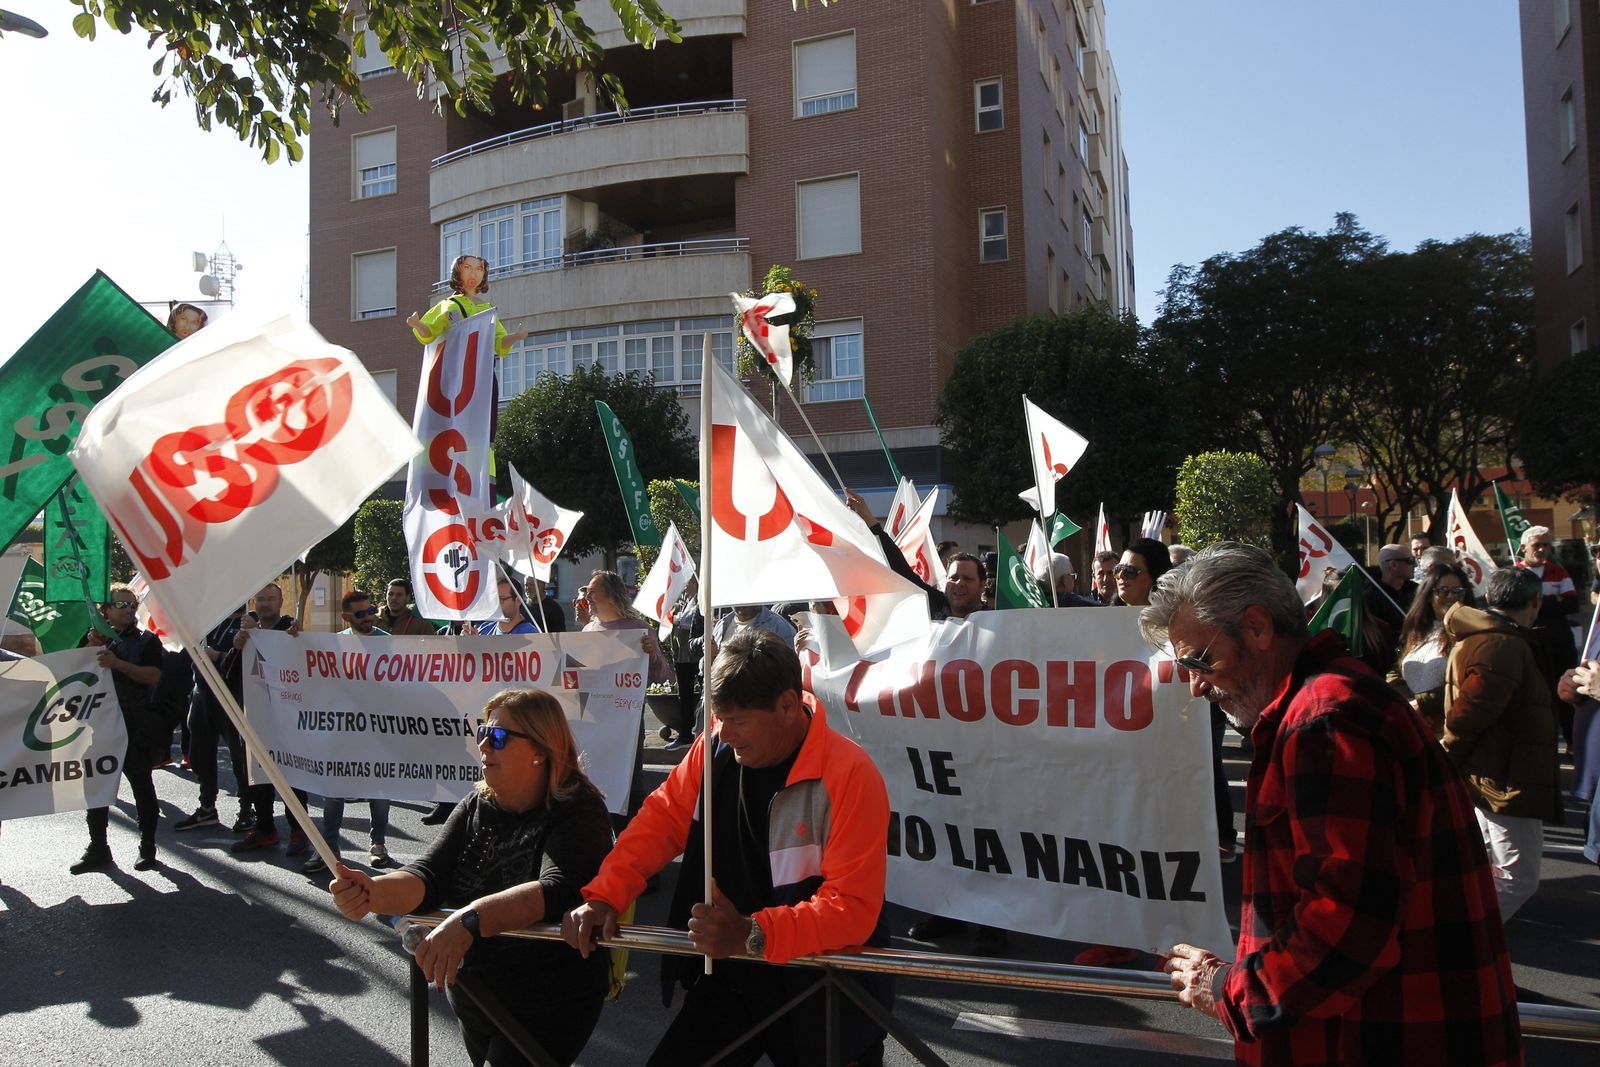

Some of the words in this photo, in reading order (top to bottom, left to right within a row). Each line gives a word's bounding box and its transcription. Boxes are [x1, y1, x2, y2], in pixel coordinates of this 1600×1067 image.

[280, 669, 300, 683] USO
[306, 650, 341, 678] POR
[342, 652, 371, 681] UN
[374, 652, 476, 682] CONVENIO
[482, 651, 541, 682] DIGNO
[615, 673, 642, 688] USO
[41, 692, 108, 726] CSIF
[298, 711, 367, 732] NUESTRO
[370, 713, 428, 735] FUTURO
[431, 713, 475, 737] ESTÁ
[282, 752, 294, 767] LAS
[293, 754, 324, 776] EMPRESAS
[326, 761, 370, 777] PIRATAS
[374, 762, 396, 778] QUE
[399, 763, 432, 779] PAGAN
[436, 764, 456, 780] POR
[906, 747, 962, 796] LE
[944, 823, 1012, 875] LA
[1020, 832, 1207, 902] NARIZ
